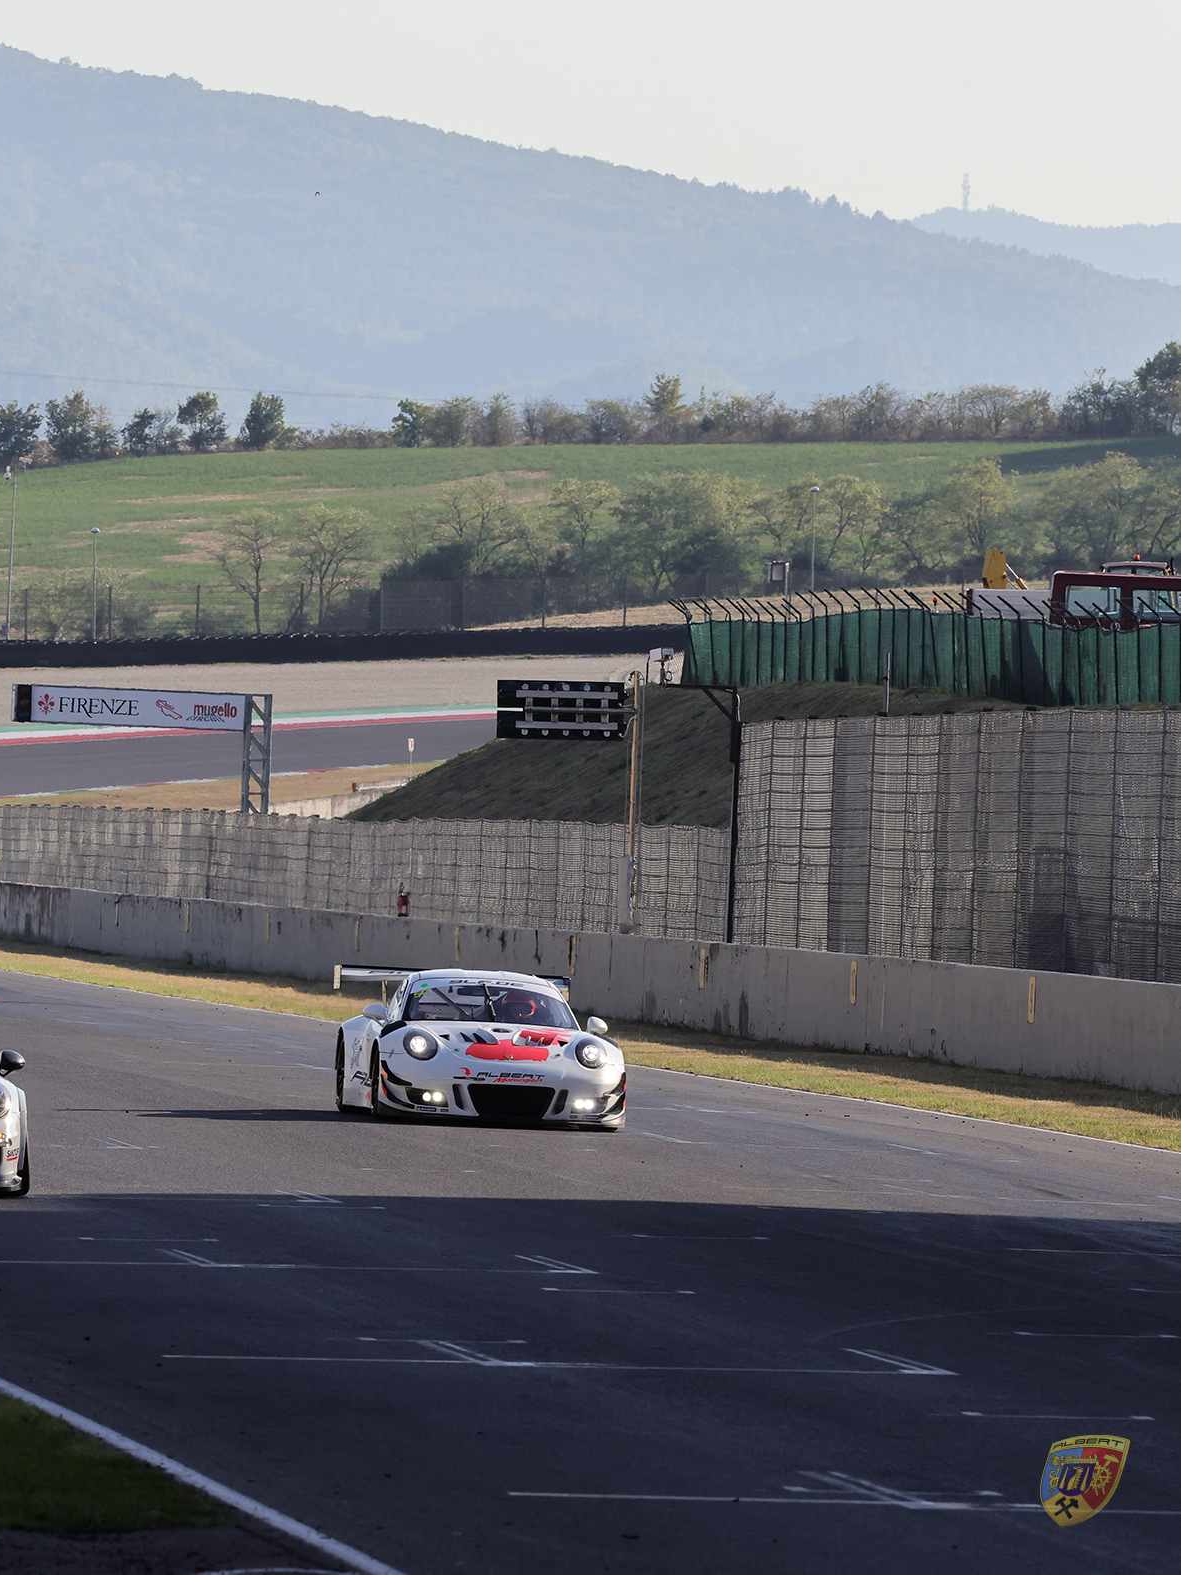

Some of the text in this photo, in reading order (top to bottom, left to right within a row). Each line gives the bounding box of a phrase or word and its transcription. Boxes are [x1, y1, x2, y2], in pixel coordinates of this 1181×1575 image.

[59, 696, 139, 718] FIRENZE
[193, 702, 238, 718] mugello
[185, 714, 226, 722] CIRCUIT
[476, 1071, 546, 1080] ALBERT
